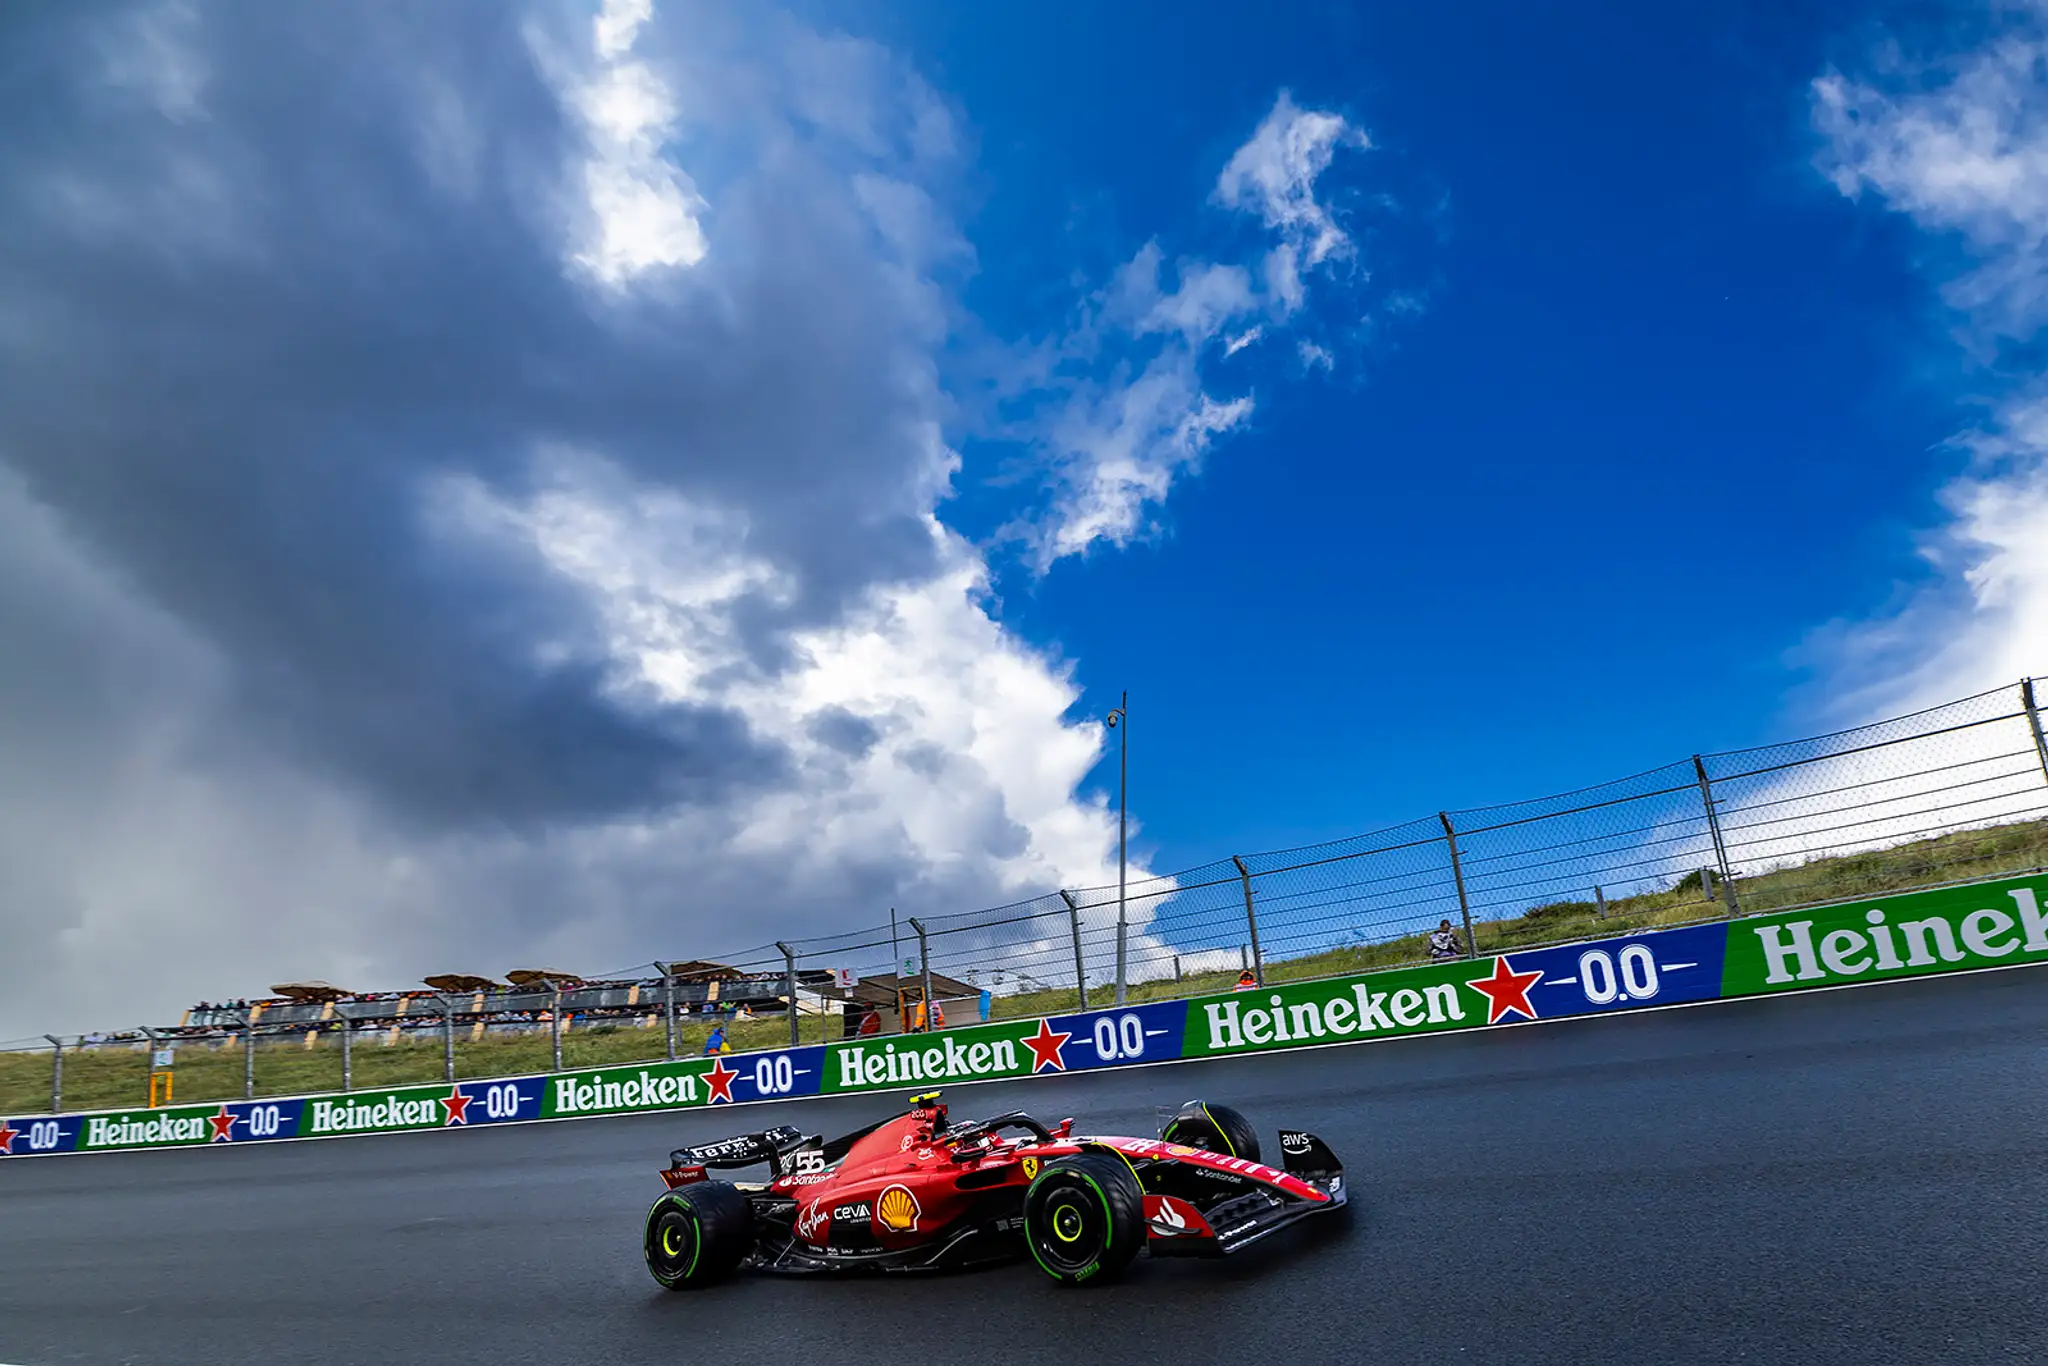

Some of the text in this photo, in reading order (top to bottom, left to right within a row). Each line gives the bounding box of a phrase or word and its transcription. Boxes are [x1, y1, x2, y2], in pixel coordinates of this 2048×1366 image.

[1203, 942, 1660, 1050] Heineken 0.0
[837, 1012, 1145, 1088] Heineken 0.0
[554, 1054, 794, 1114] Heineken 0.0
[86, 1105, 279, 1147] Heineken 0.0
[311, 1083, 518, 1133] Heineken 0.0
[29, 1121, 59, 1150] 0.0
[690, 1127, 784, 1159] Ferrai
[1282, 1132, 1310, 1146] aws
[796, 1150, 826, 1175] 55
